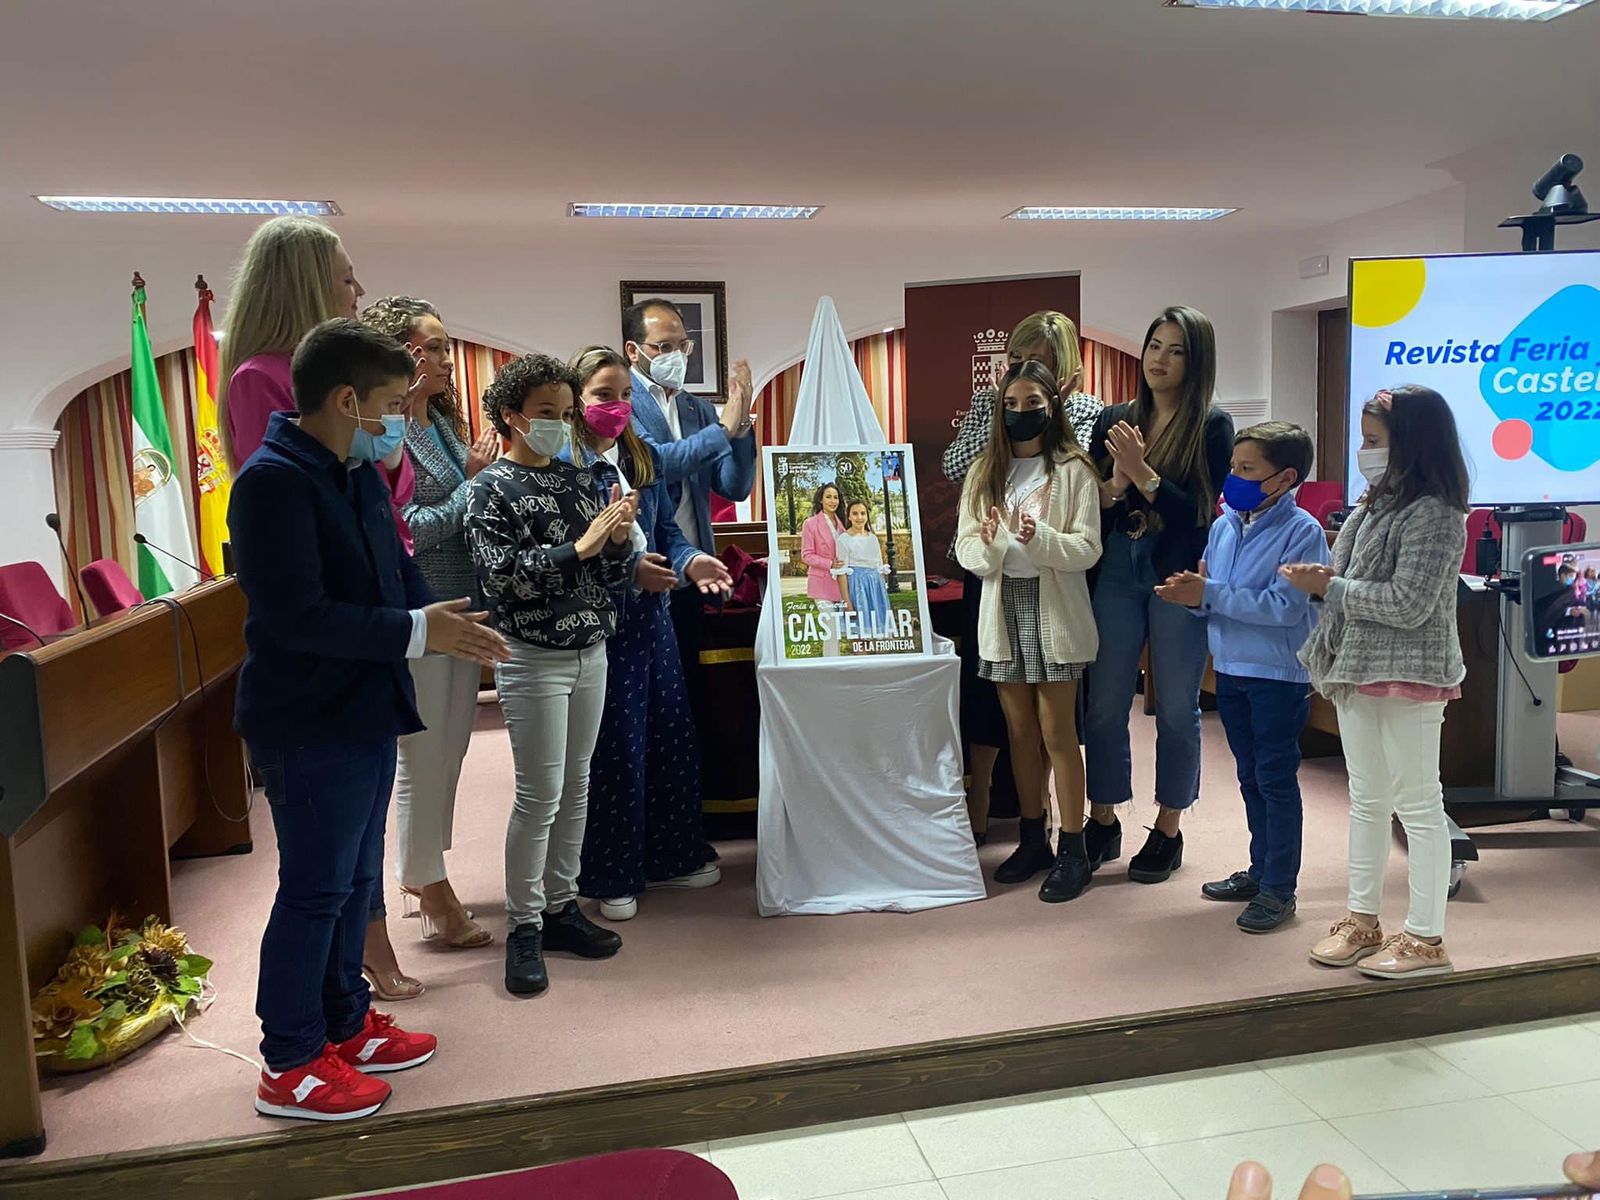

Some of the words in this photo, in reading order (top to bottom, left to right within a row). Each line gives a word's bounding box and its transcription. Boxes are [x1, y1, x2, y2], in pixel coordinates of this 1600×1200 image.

[1385, 339, 1500, 365] Revista
[1509, 336, 1590, 361] Feria
[788, 609, 913, 642] CASTELLAR
[791, 644, 811, 655] 2022
[853, 641, 862, 652] DE
[864, 641, 875, 652] LA
[876, 640, 915, 651] FRONTERA
